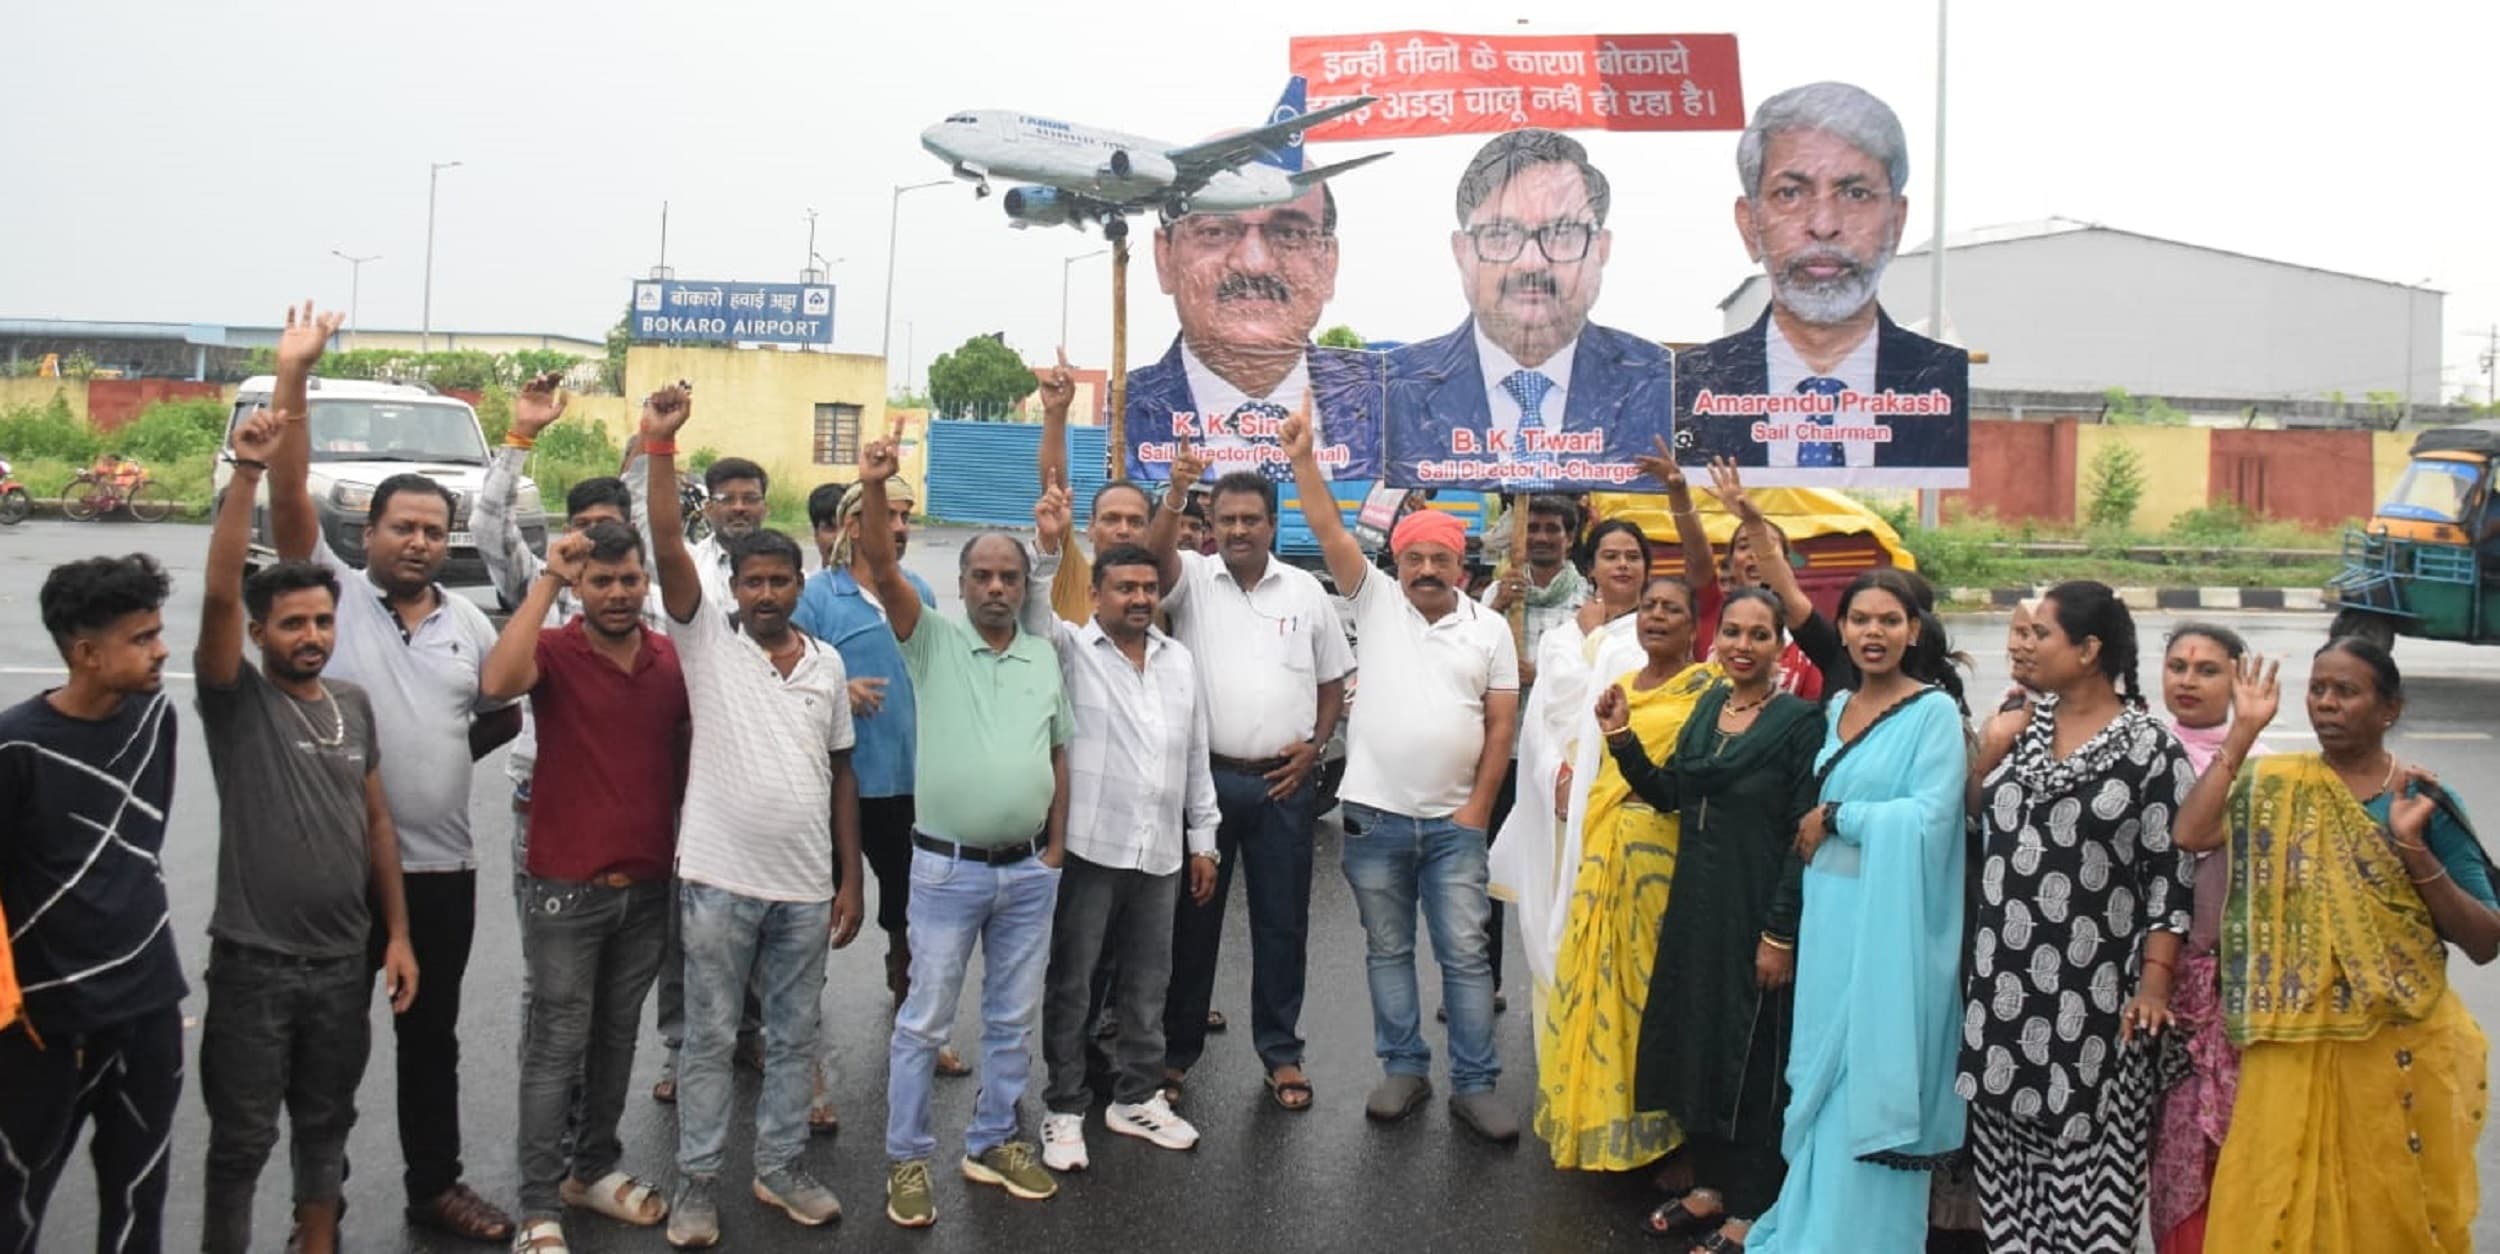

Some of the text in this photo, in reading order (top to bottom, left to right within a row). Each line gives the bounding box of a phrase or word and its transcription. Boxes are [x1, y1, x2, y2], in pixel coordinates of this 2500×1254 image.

[1469, 41, 1498, 71] के
[1504, 49, 1586, 76] कारण
[1595, 40, 1690, 75] बोकारो
[1463, 86, 1529, 123] चालू
[1588, 83, 1621, 116] हो
[1626, 89, 1673, 116] रहा
[670, 286, 798, 313] बोकारो हवाई अड्डा
[642, 316, 820, 337] BOKARO AIRPORT
[1694, 388, 1951, 415] Amarendu Prakash
[1173, 413, 1281, 436] K. K. Sin
[1752, 422, 1892, 442] Sail Chairman
[1453, 427, 1603, 453] B. K. Tiwari
[1139, 443, 1176, 463] Sail
[1418, 460, 1640, 483] Sail Director In-Charge
